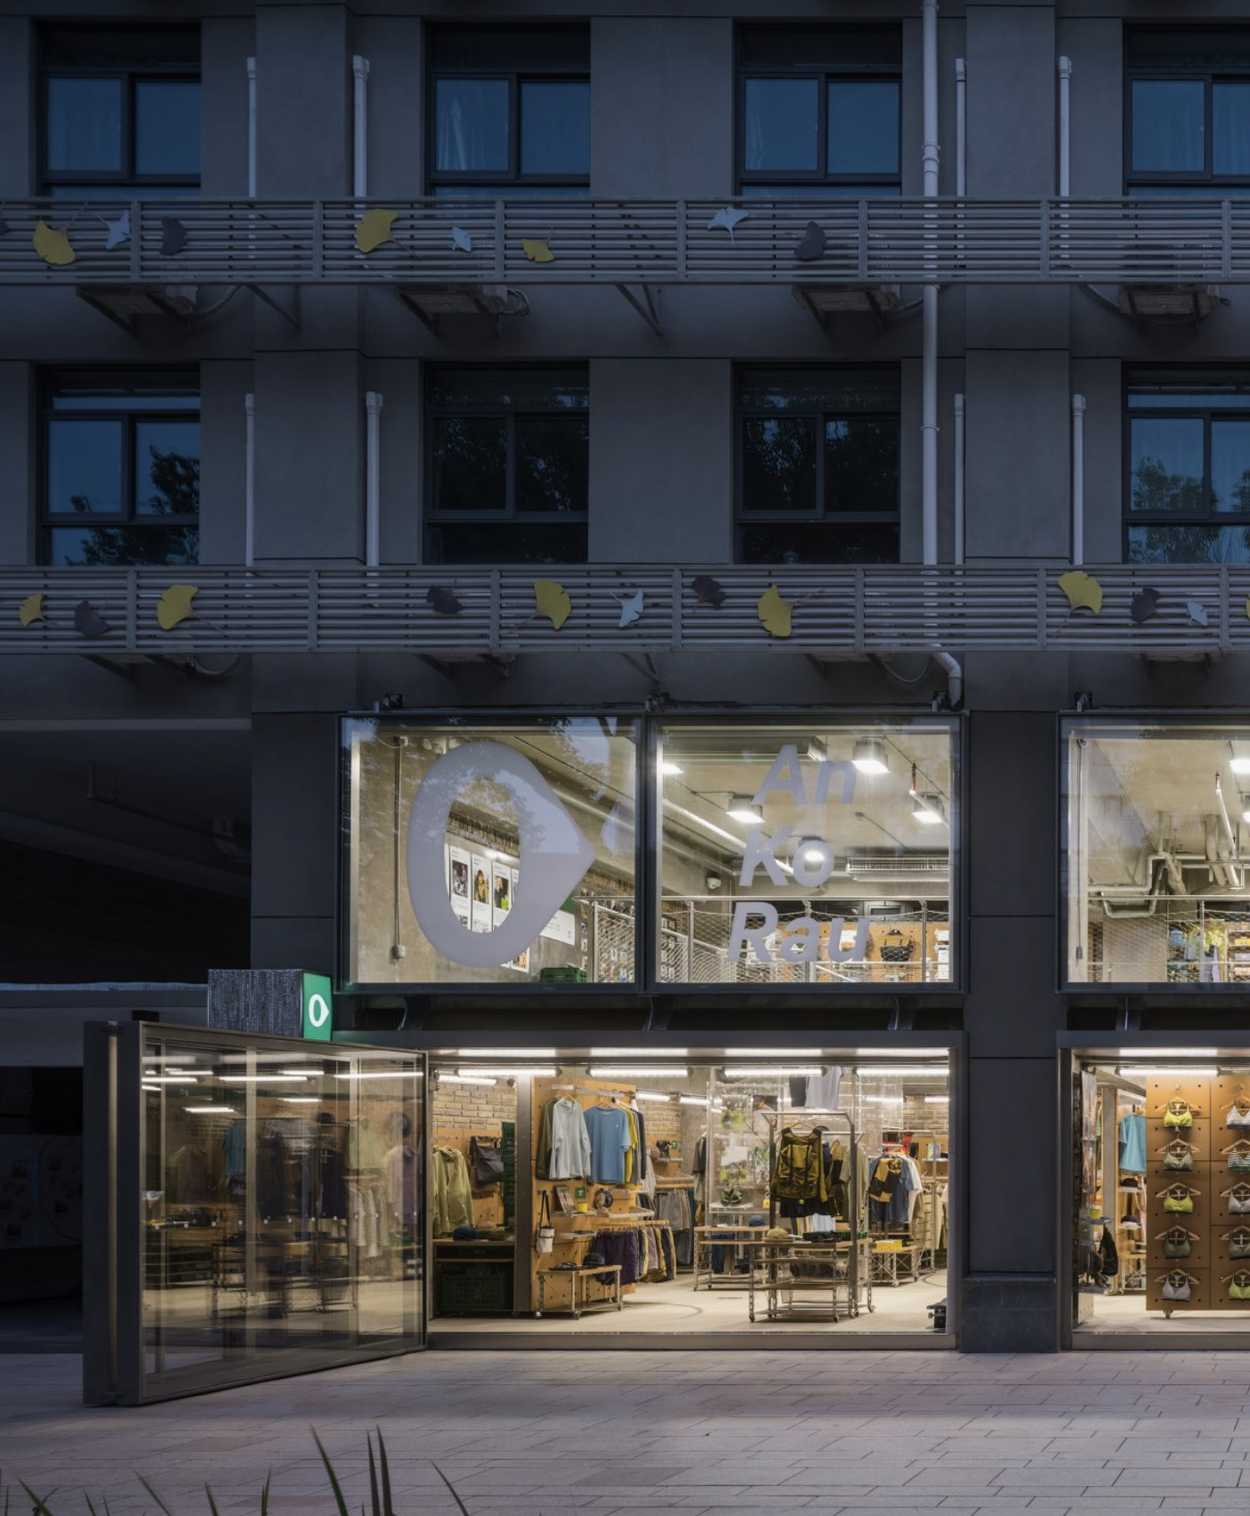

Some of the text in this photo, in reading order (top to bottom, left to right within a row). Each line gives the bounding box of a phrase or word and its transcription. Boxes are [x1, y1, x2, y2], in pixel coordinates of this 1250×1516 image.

[751, 744, 857, 805] An
[738, 825, 835, 887] Ko
[727, 901, 871, 963] Rau
